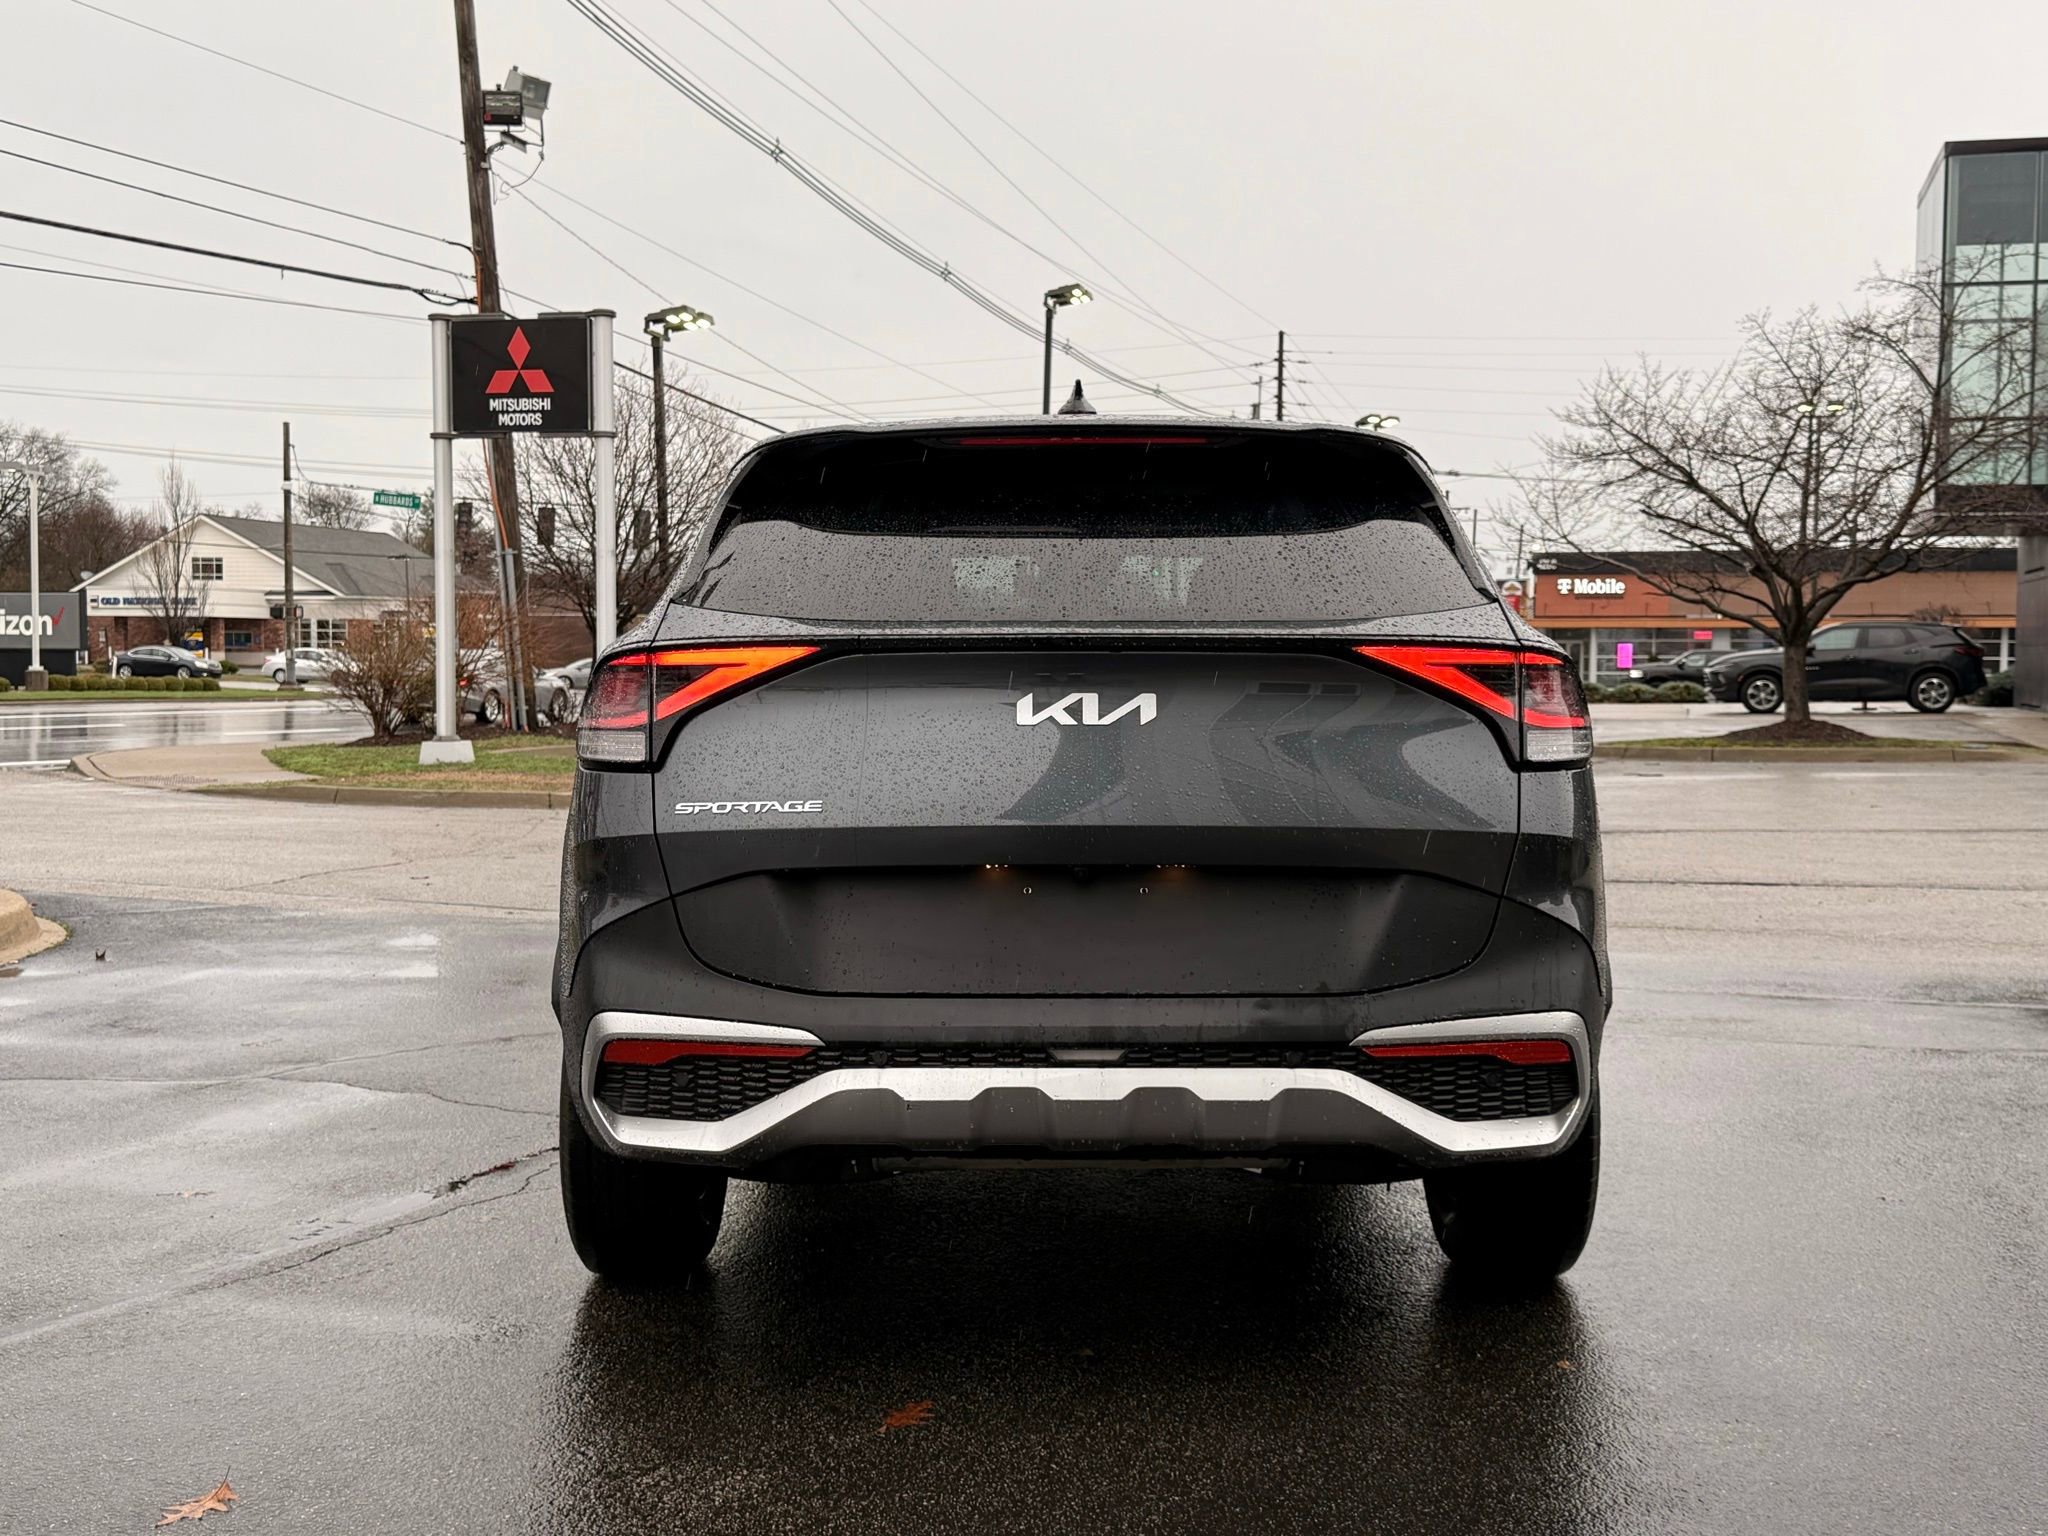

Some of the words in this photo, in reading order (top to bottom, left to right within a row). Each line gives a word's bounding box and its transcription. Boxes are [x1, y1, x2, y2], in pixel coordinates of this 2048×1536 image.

[489, 398, 551, 411] MITSUBISHI
[498, 413, 543, 426] MOTORS
[1017, 693, 1157, 726] KIA
[675, 800, 823, 815] SPORTAGE
